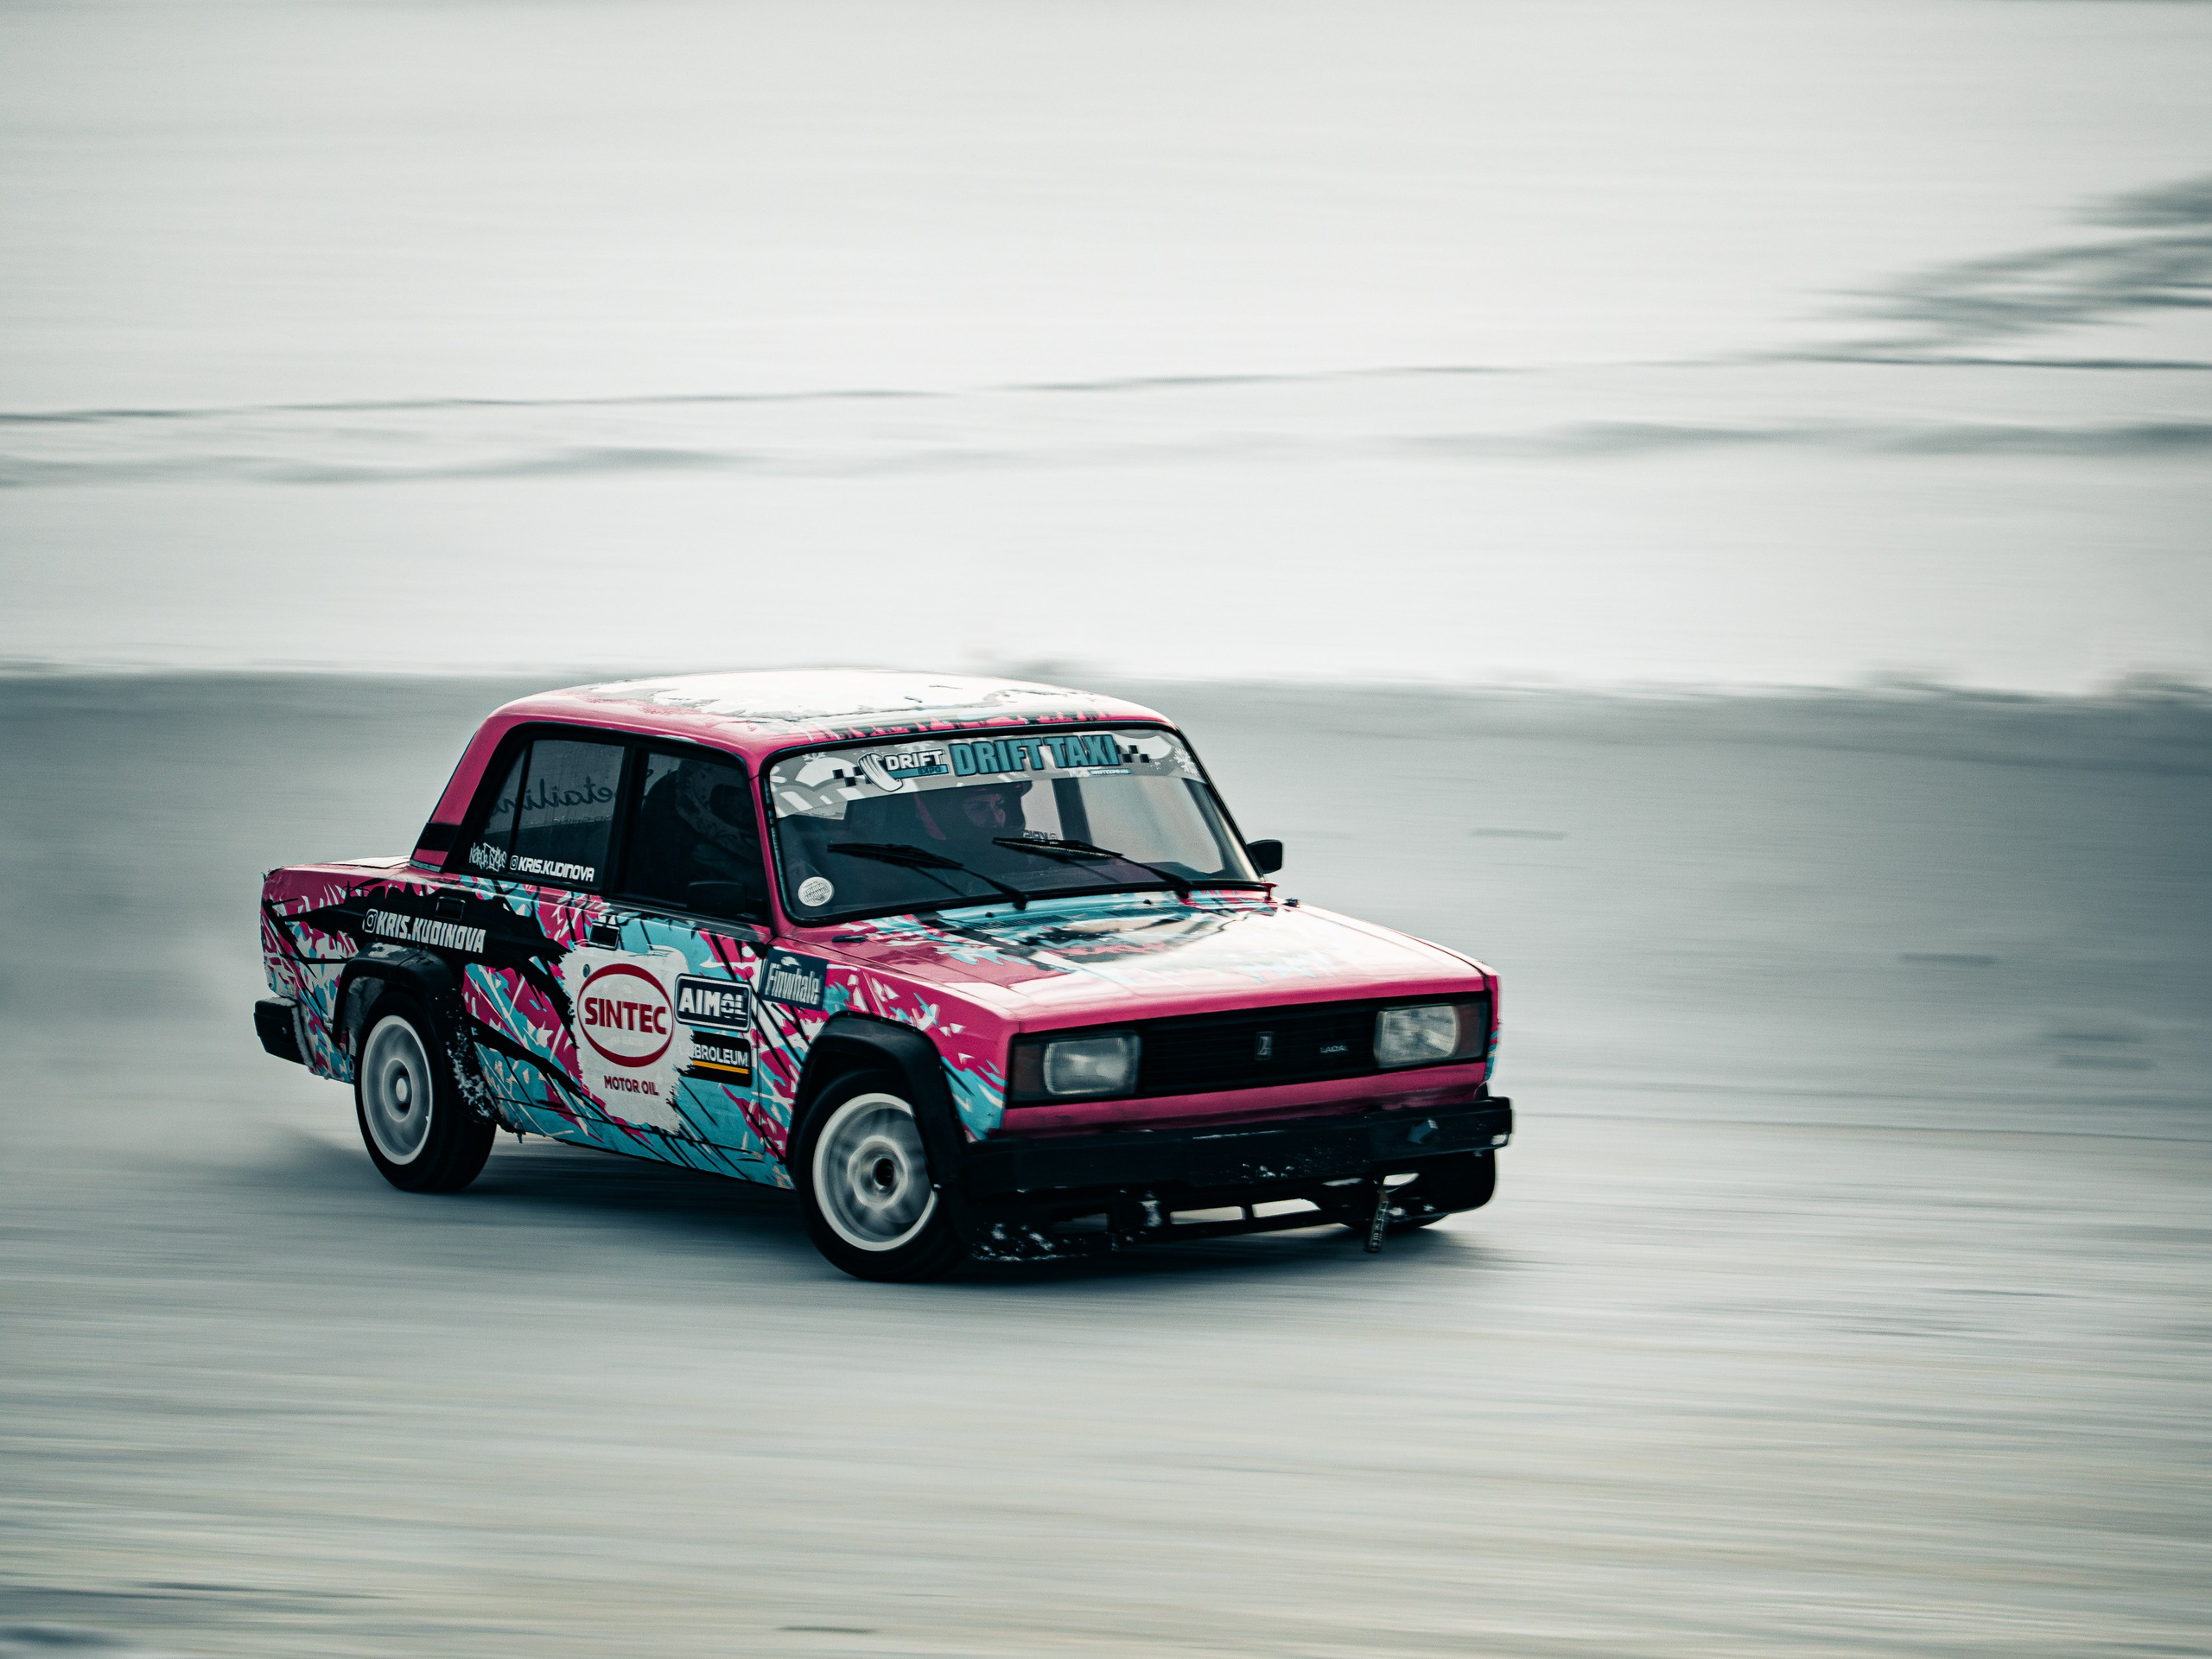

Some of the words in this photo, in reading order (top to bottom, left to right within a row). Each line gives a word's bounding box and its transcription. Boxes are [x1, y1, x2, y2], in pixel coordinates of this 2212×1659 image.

[884, 750, 943, 771] DRIFT
[918, 766, 942, 775] EXPO
[949, 738, 1044, 776] DRIFT
[1045, 735, 1121, 768] TAXI
[376, 911, 486, 954] KRIS.KUDINOVA
[765, 963, 820, 1005] Finwhale
[584, 997, 667, 1035] SINTEC
[678, 988, 747, 1020] AIMOL
[693, 1044, 748, 1067] BROLEUM
[604, 1075, 640, 1094] MOTOR
[641, 1080, 660, 1096] OIL
